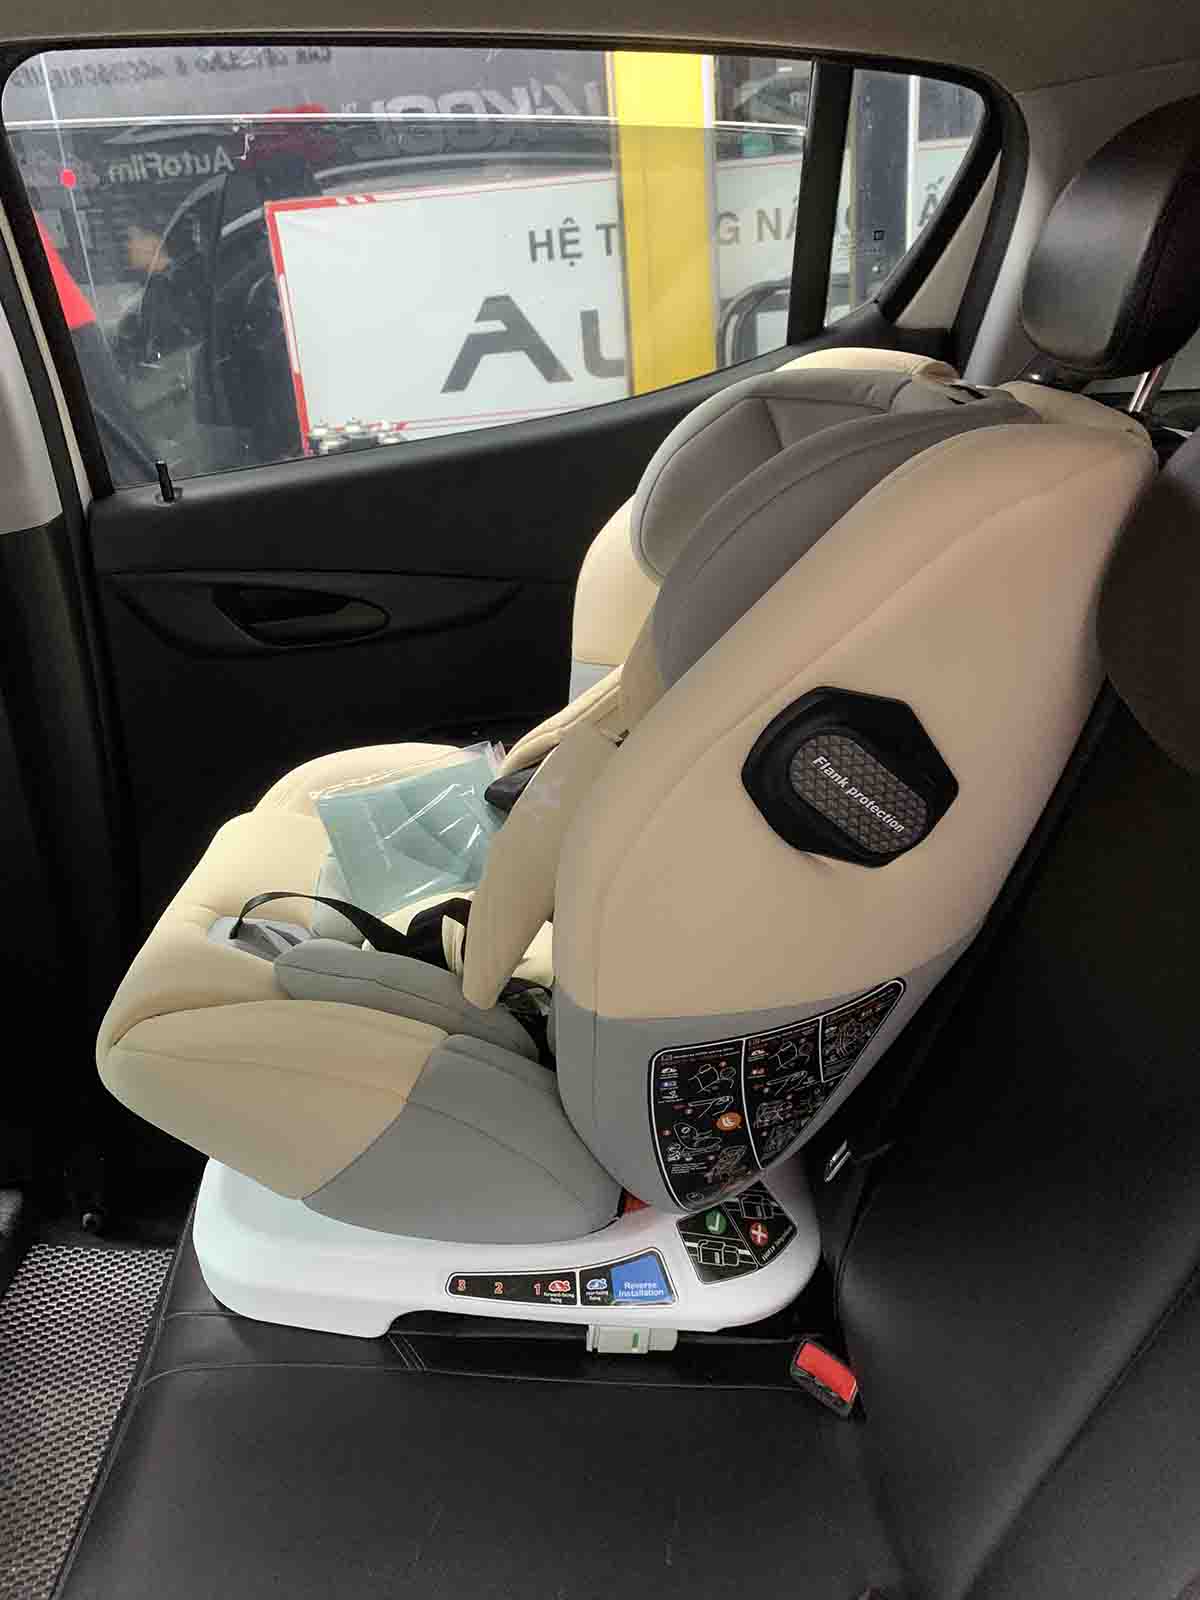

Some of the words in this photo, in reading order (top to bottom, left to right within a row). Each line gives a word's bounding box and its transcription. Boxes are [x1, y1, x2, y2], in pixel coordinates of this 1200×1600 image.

[527, 216, 583, 268] HỆ
[439, 294, 626, 394] AU
[812, 755, 849, 788] Flank
[846, 786, 905, 833] protection
[494, 1281, 504, 1295] 2
[533, 1283, 541, 1297] 1
[618, 1287, 665, 1298] Installation
[623, 1281, 658, 1290] Reverse
